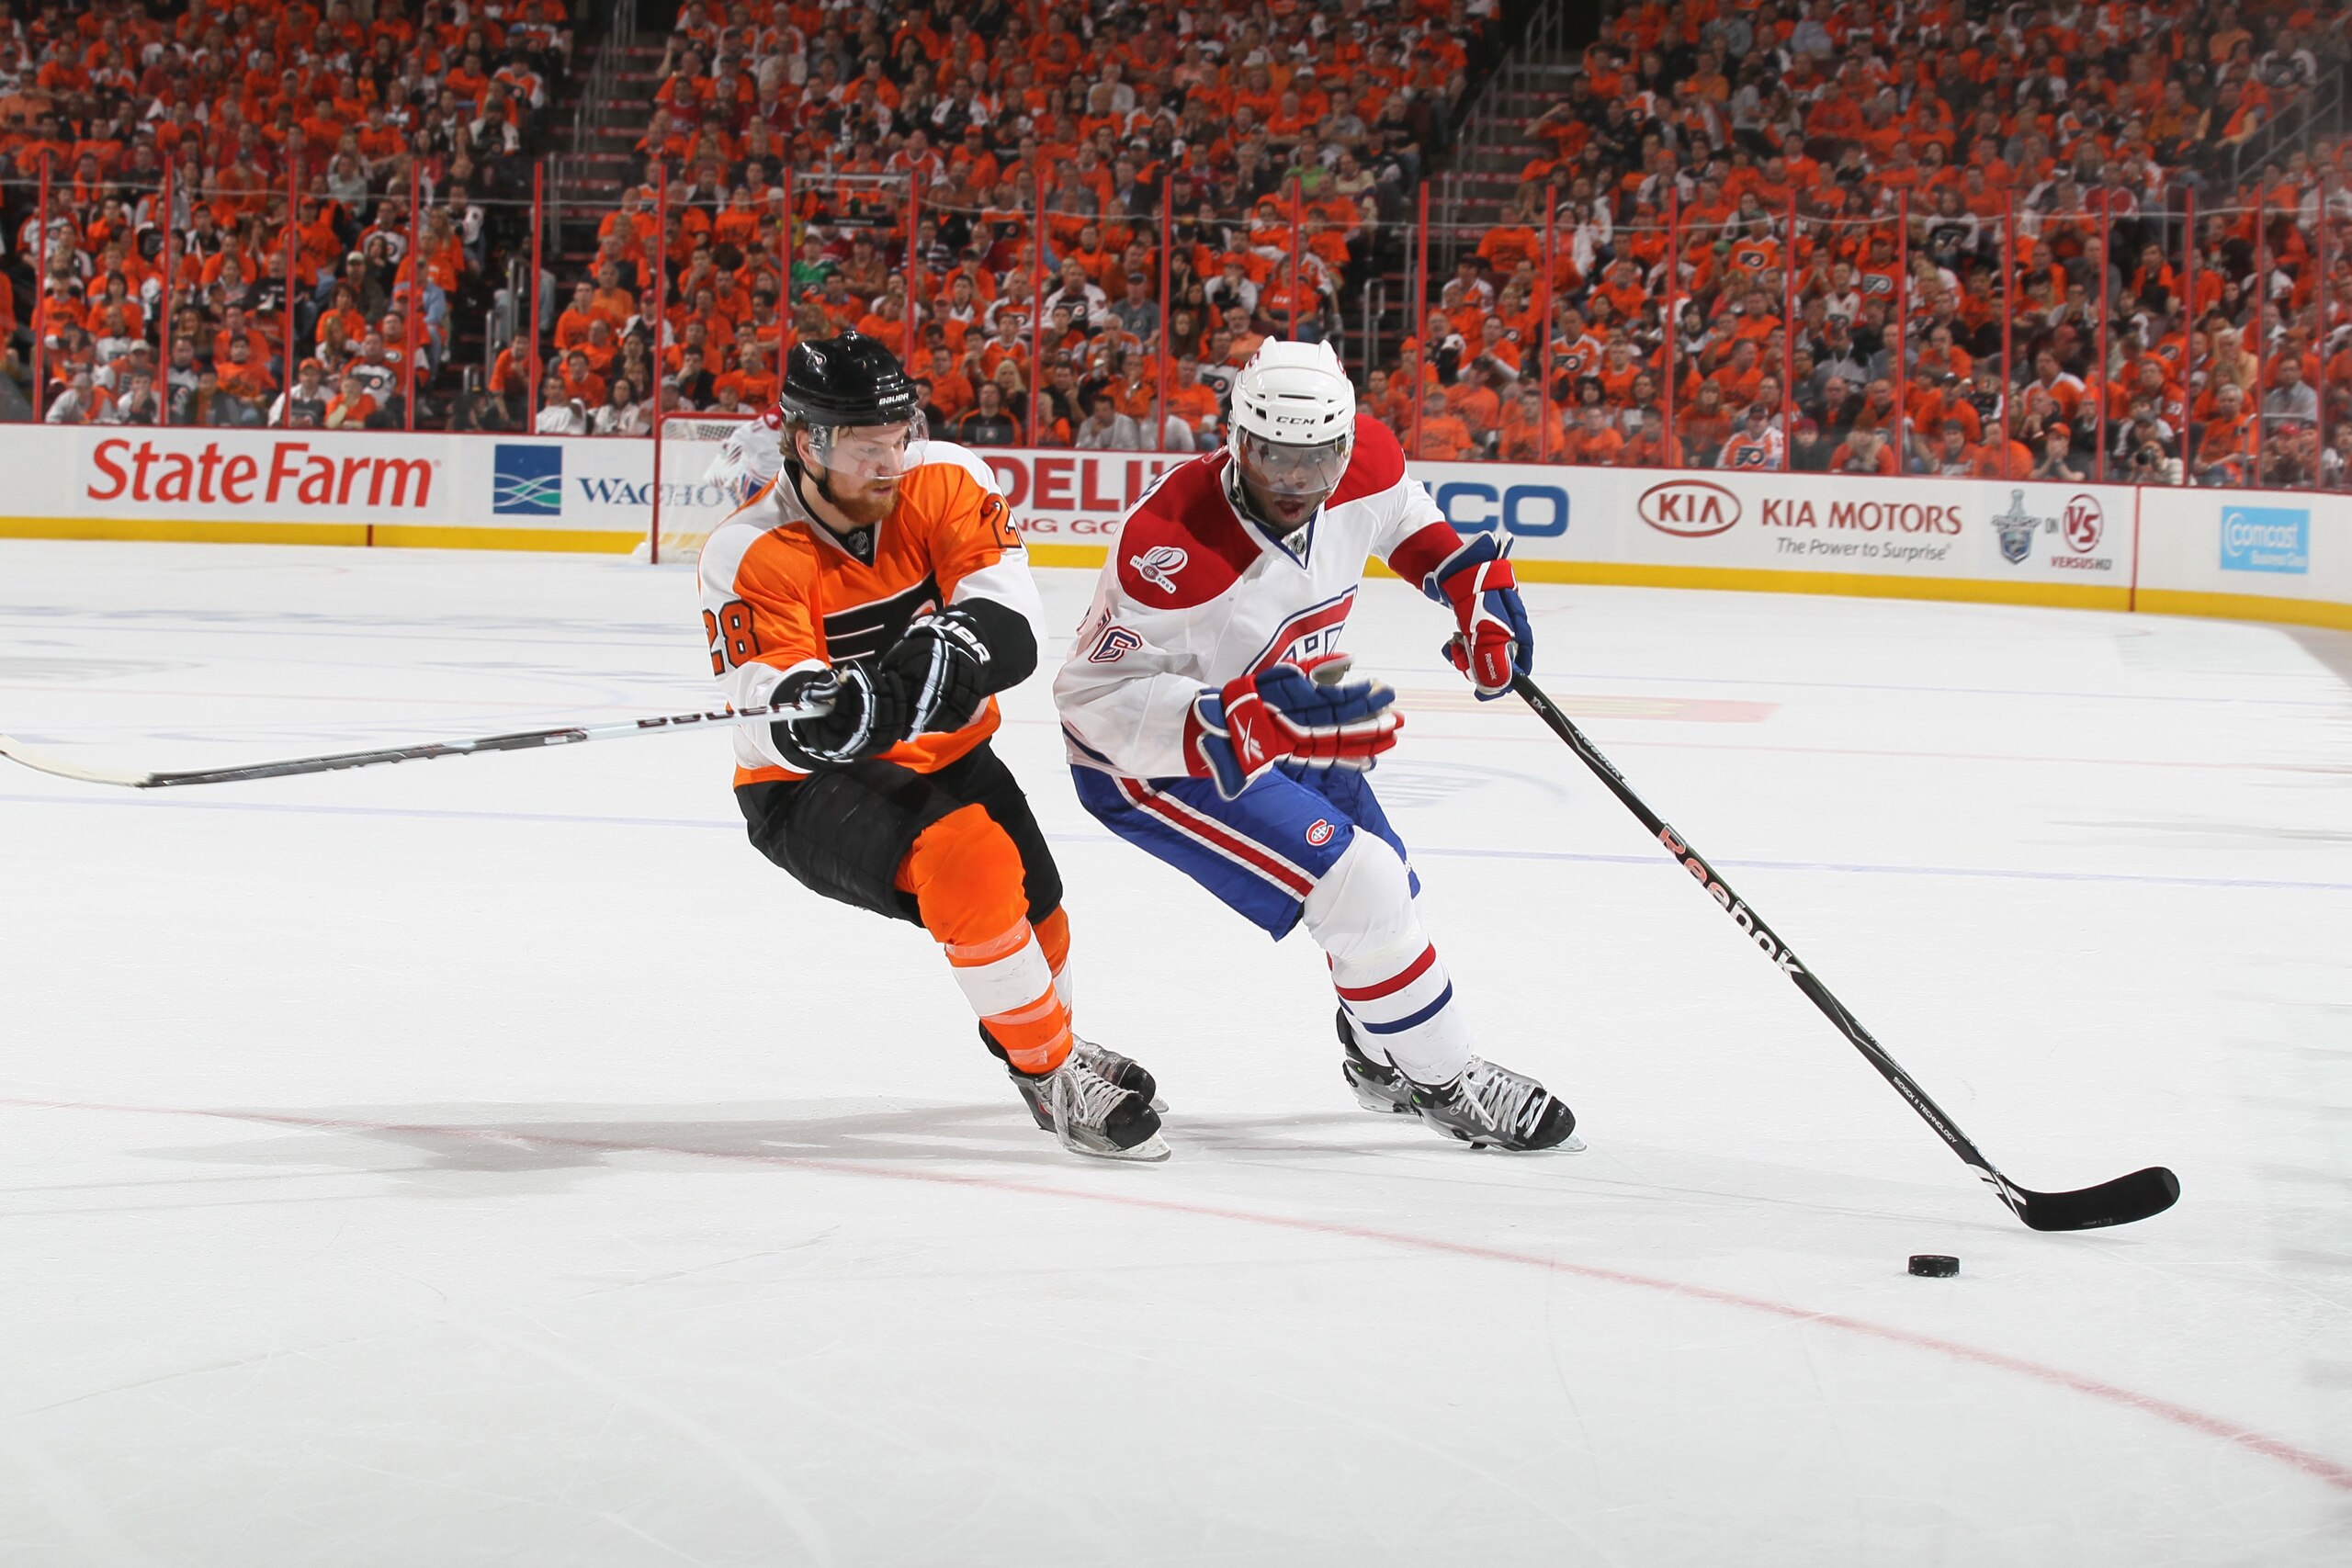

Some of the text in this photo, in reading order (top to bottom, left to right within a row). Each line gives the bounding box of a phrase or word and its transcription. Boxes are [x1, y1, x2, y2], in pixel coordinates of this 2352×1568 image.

[878, 392, 909, 406] BAUER
[1275, 415, 1317, 425] CCM
[1423, 480, 1570, 537] CO
[1658, 493, 1724, 524] KIA
[1760, 499, 1962, 536] KIA MOTORS
[1776, 537, 1948, 562] The Power to Surprise
[702, 599, 762, 677] 28
[1485, 652, 1498, 681] Reebok
[1657, 826, 1805, 977] Reebok
[1919, 1102, 1959, 1144] TECHNOLOGY
